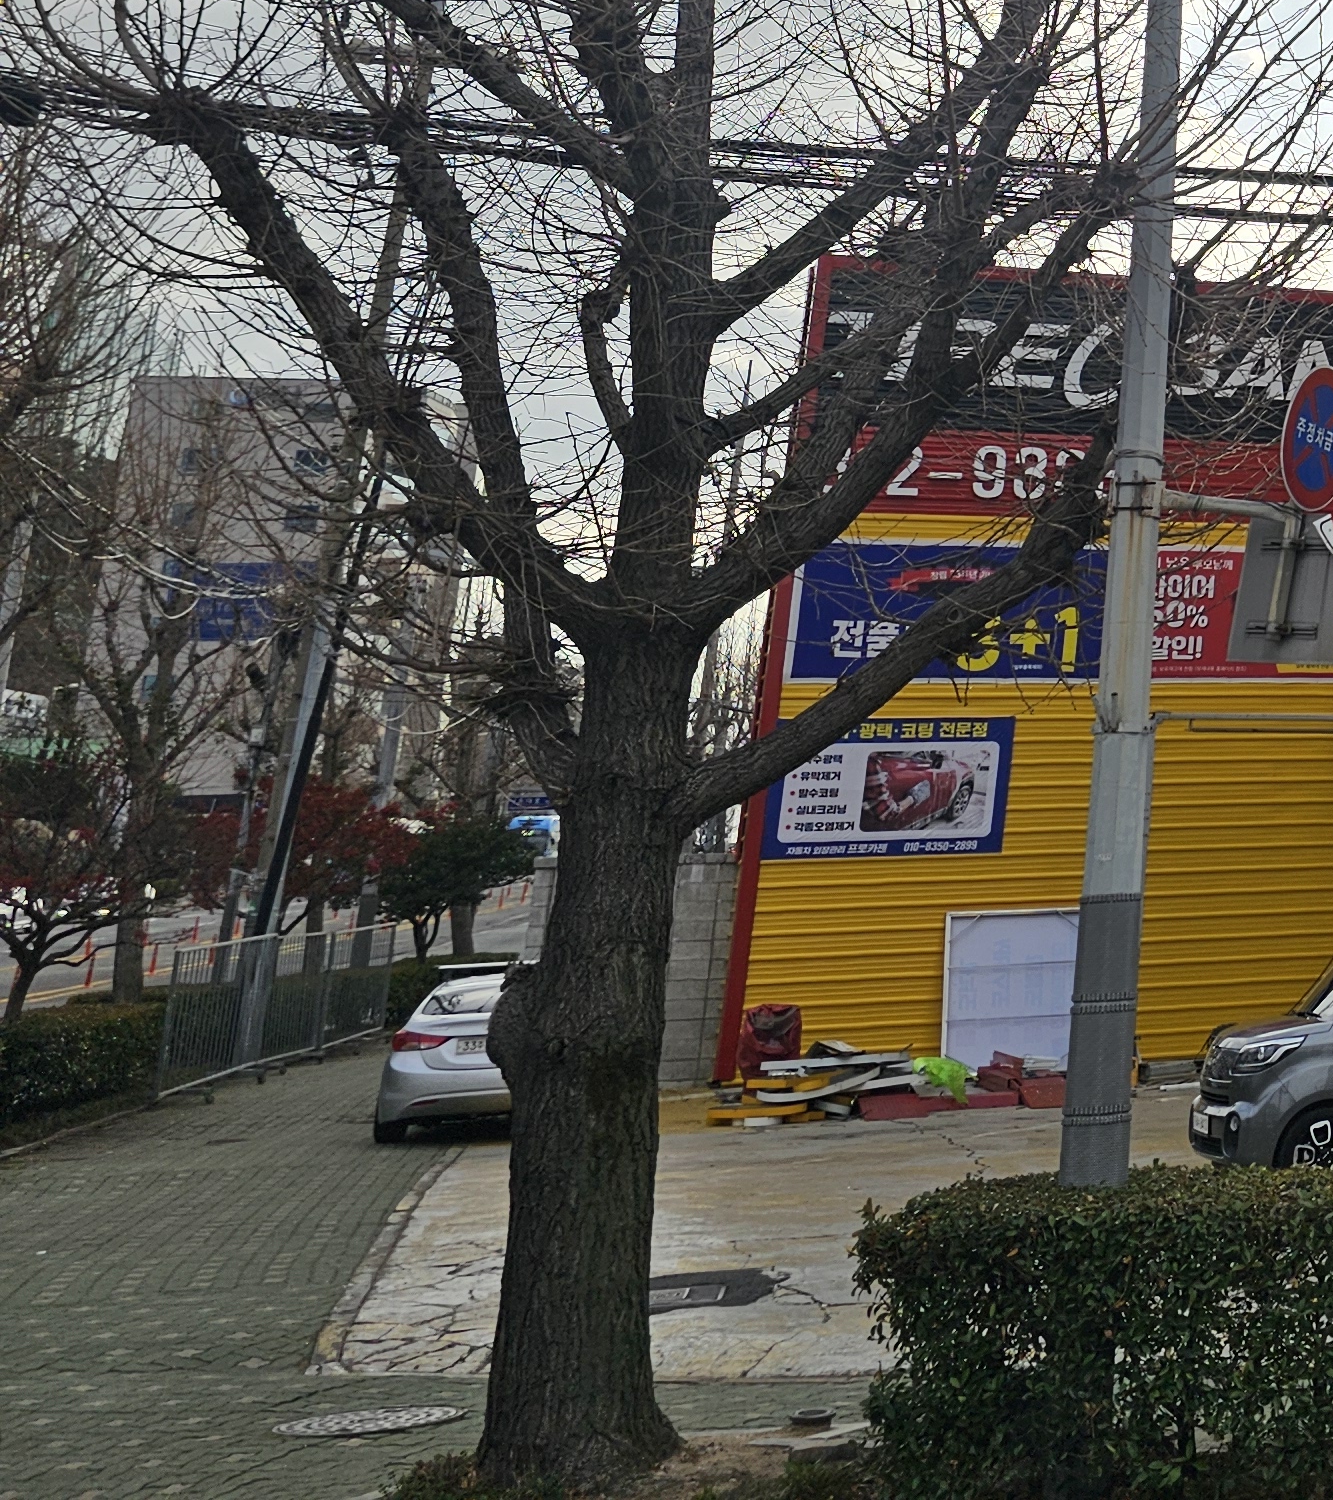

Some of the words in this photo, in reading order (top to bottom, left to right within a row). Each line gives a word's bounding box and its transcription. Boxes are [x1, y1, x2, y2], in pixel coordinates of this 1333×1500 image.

[939, 721, 988, 738] 전문점
[800, 771, 841, 781] 유막제거
[798, 788, 839, 798] 발수코팅
[796, 805, 847, 815] 실내크리닝
[794, 821, 855, 832] 각종오염제거
[903, 840, 978, 853] 010-8350-2899
